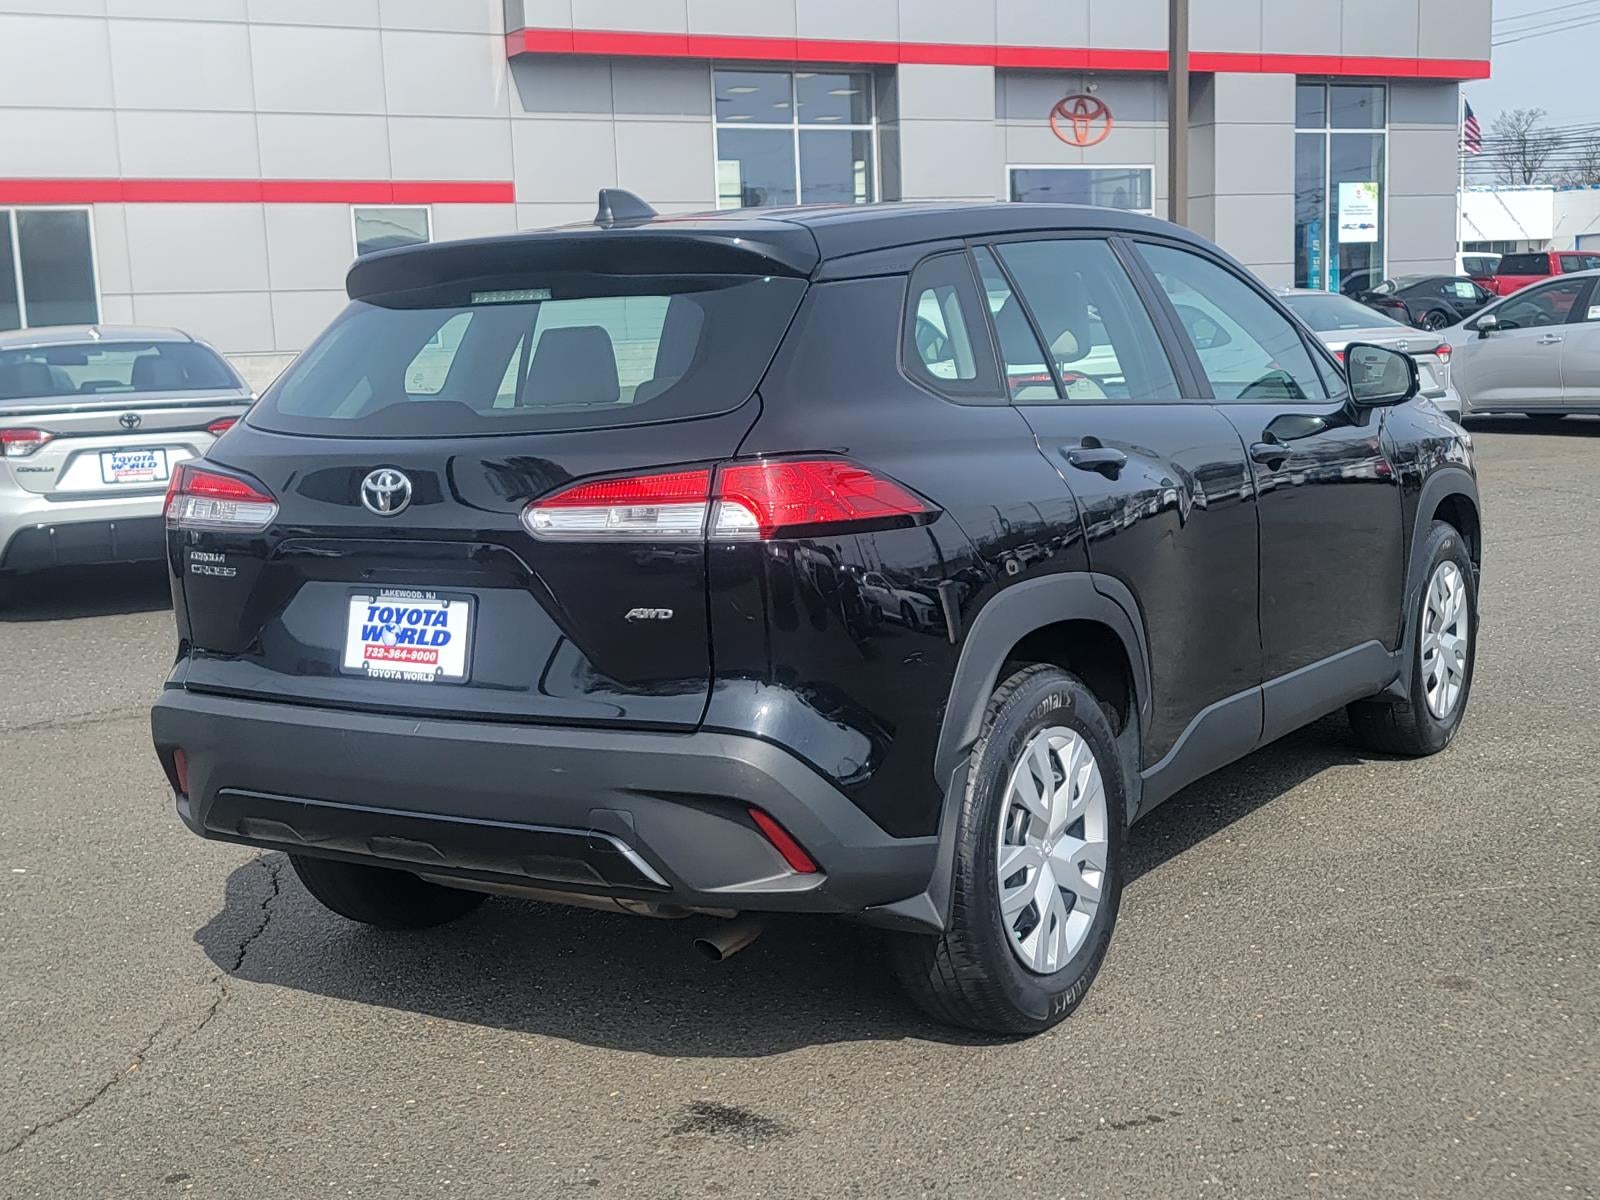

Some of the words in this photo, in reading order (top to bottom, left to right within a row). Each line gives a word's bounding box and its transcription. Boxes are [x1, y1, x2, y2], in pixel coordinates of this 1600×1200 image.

[111, 455, 155, 463] TOYOTA
[191, 564, 237, 577] CROSS
[426, 592, 436, 600] NJ
[367, 605, 449, 627] TOYOTA
[624, 608, 674, 622] AWD
[361, 624, 452, 647] WORLD
[366, 647, 437, 661] 732-364-9000
[367, 668, 401, 679] TOYOTA
[403, 671, 435, 682] WORLD
